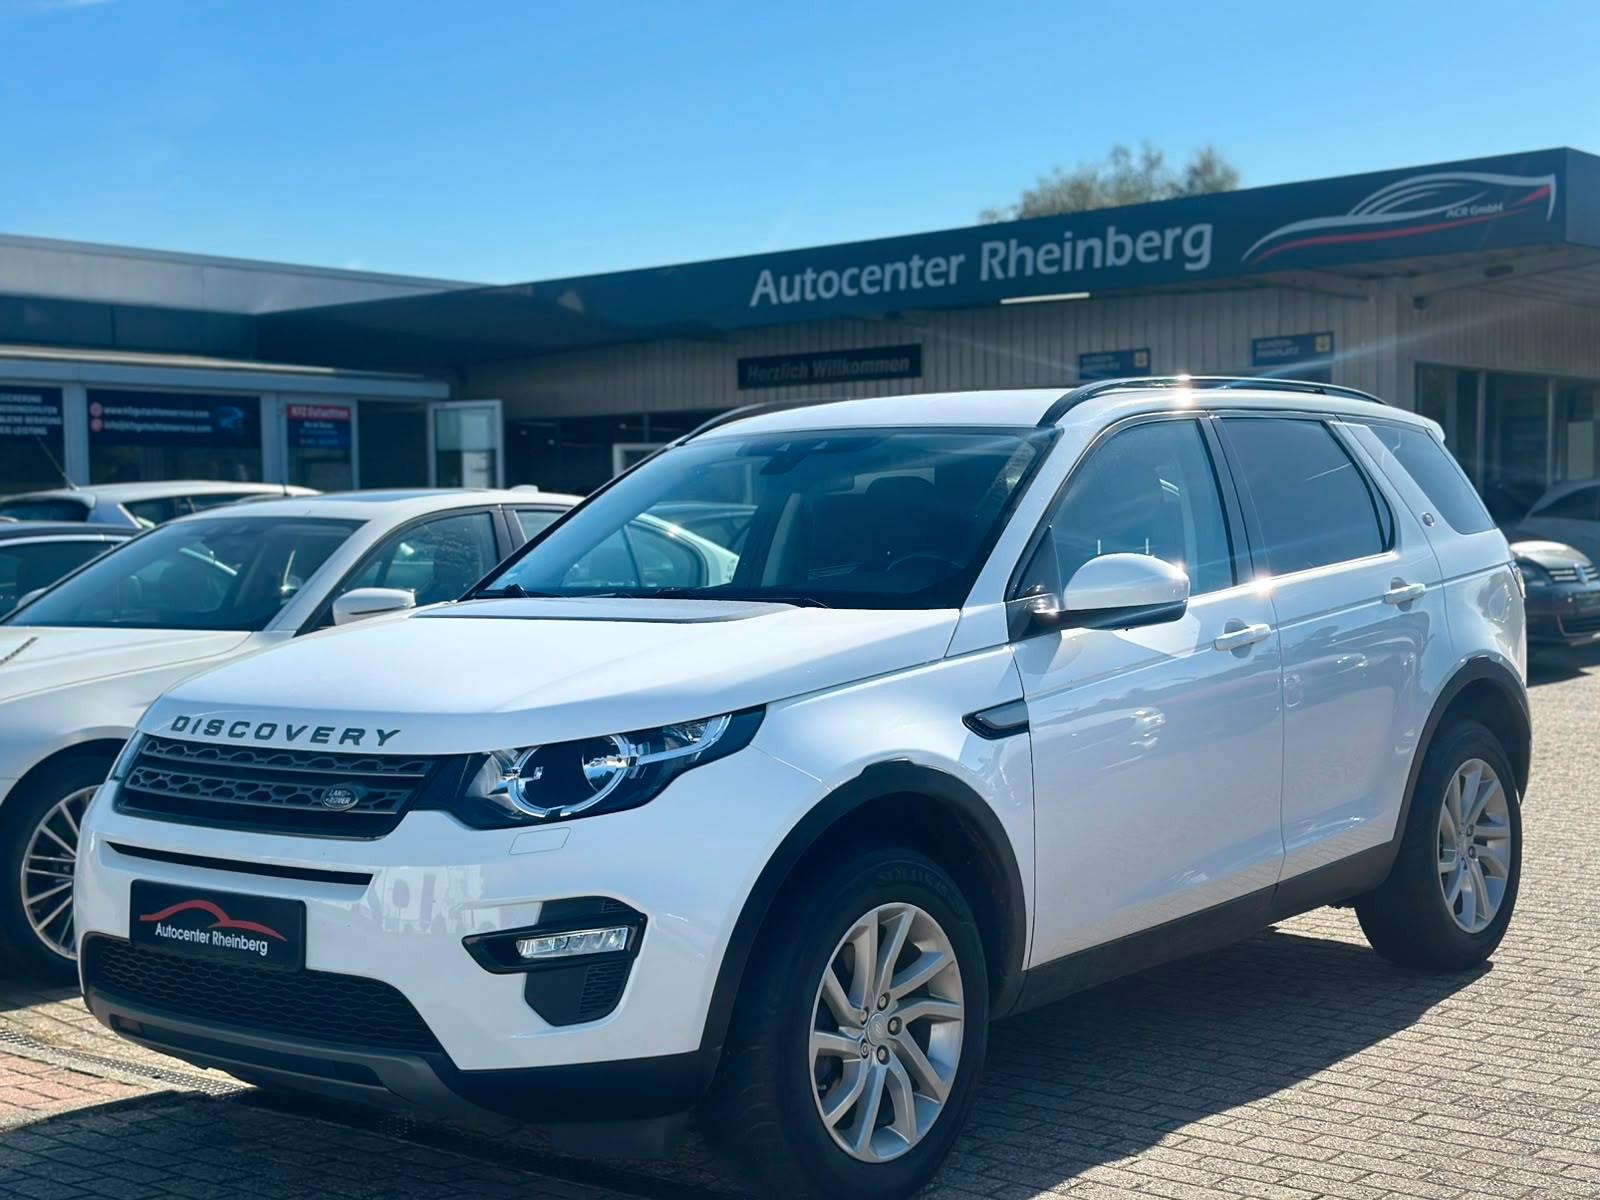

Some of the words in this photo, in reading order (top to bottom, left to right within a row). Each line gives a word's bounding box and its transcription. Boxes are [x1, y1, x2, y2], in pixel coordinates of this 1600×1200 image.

[750, 254, 966, 308] Autocenter
[980, 223, 1214, 282] Rheinberg
[747, 361, 809, 382] Herzlich
[812, 356, 910, 378] Willkommen
[170, 715, 401, 747] DISCOVERY
[155, 922, 210, 944] Autocenter
[212, 931, 268, 956] Rheinberg
